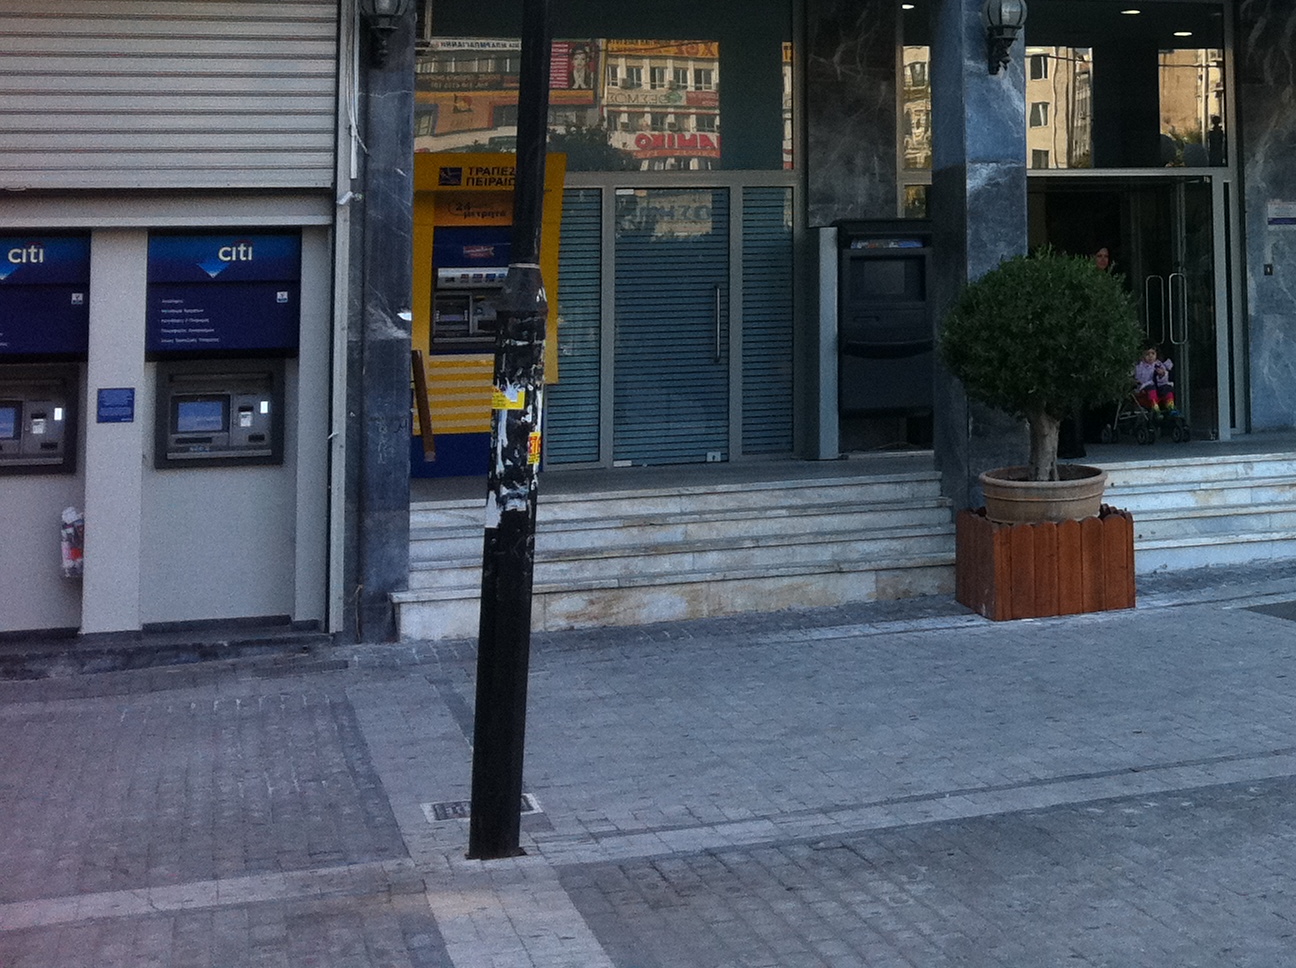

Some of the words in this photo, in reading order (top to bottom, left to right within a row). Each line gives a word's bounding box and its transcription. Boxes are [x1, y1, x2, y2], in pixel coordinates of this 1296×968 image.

[469, 166, 516, 176] ΤΡΑΠΕΖ
[466, 177, 516, 186] ΠΕΙΡΑΙΩ
[8, 245, 45, 263] citi
[218, 242, 253, 261] citi
